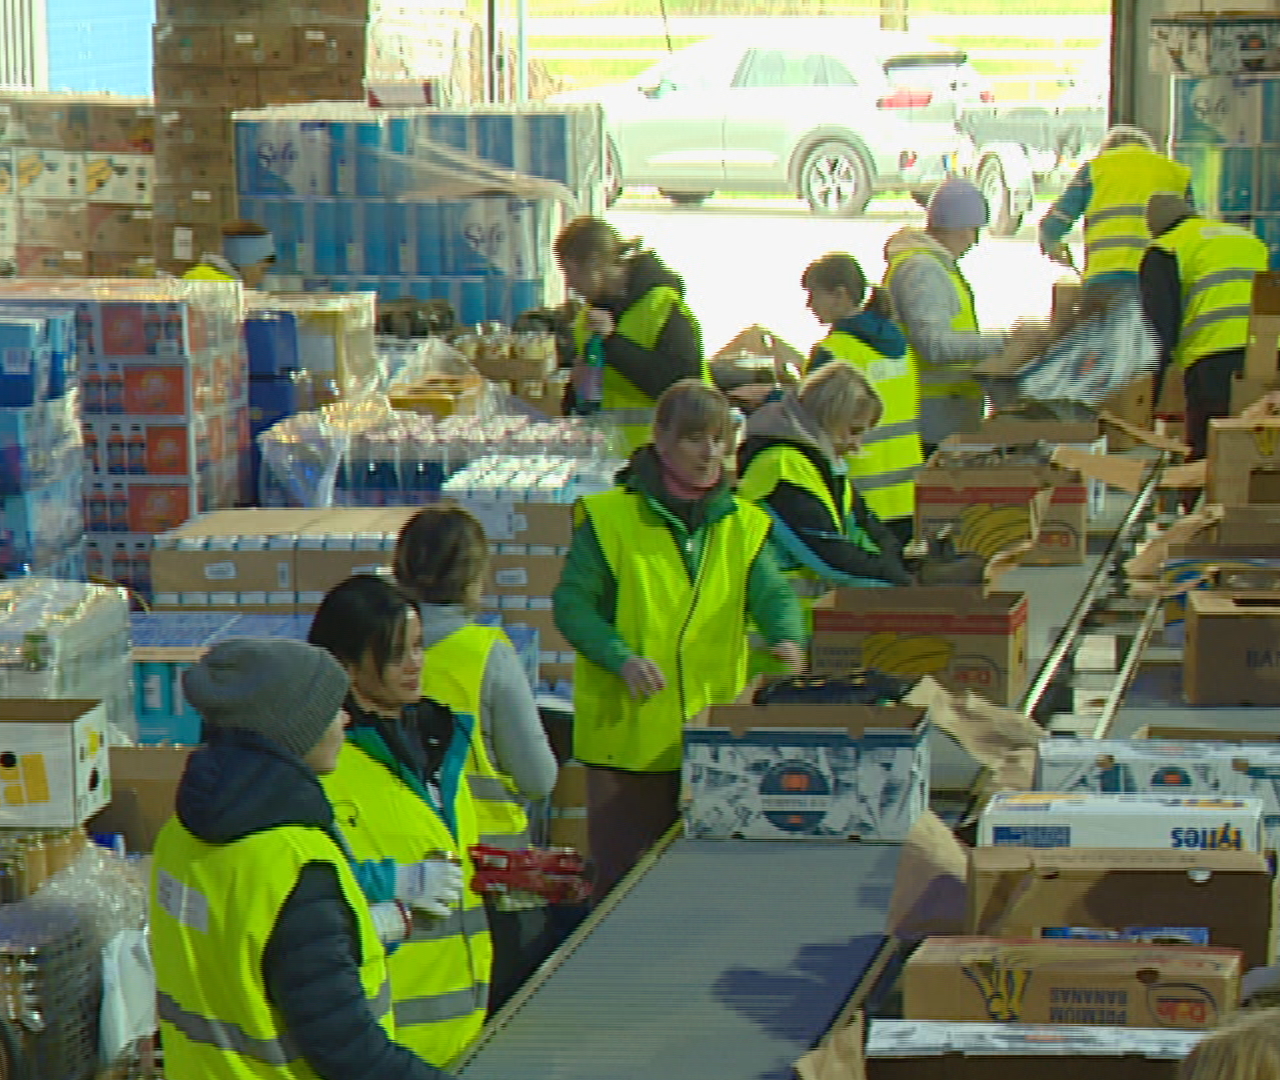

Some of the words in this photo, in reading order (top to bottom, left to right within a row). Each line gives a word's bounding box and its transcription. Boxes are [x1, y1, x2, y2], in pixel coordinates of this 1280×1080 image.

[1048, 986, 1127, 1005] BANANAS
[1049, 1005, 1127, 1024] PREMIUM
[1155, 1001, 1205, 1022] Dole
